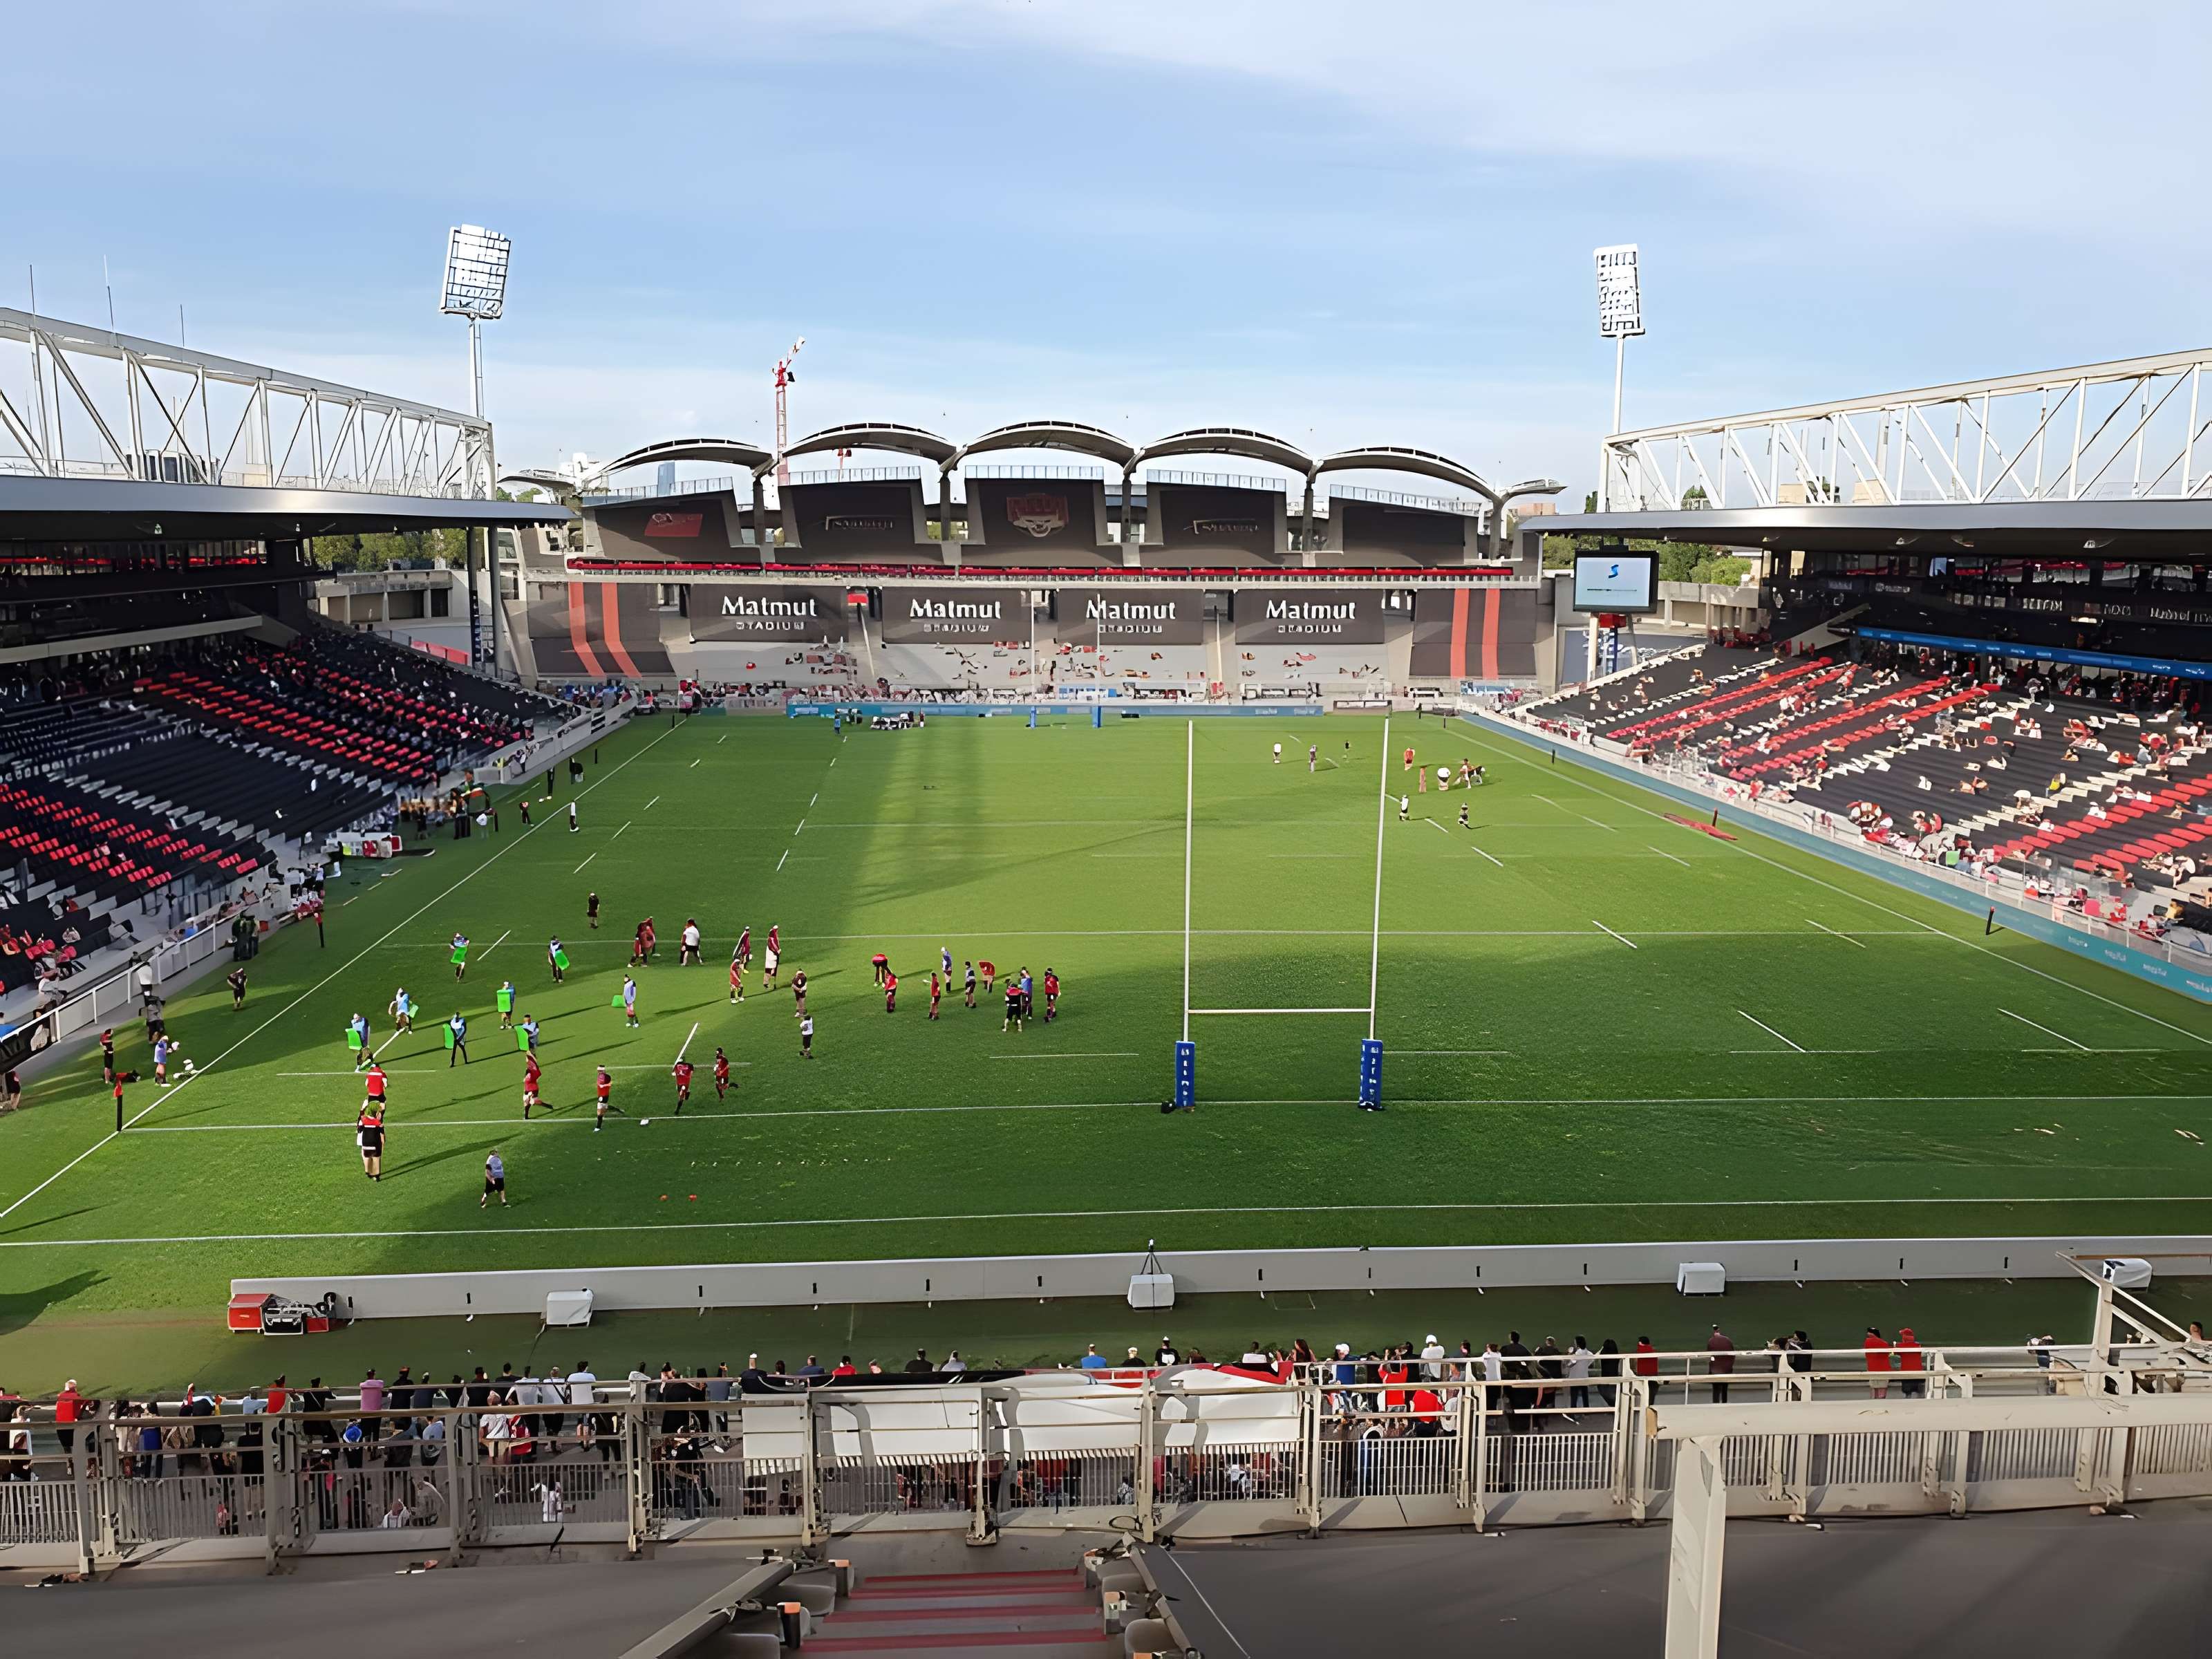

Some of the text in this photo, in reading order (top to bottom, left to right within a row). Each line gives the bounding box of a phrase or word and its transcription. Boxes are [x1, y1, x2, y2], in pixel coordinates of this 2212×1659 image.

[722, 596, 817, 617] Matmut
[910, 599, 1001, 619] Matmut
[1086, 599, 1176, 620] Matmut
[1266, 600, 1356, 620] Matmut
[1277, 624, 1342, 633] DIUM
